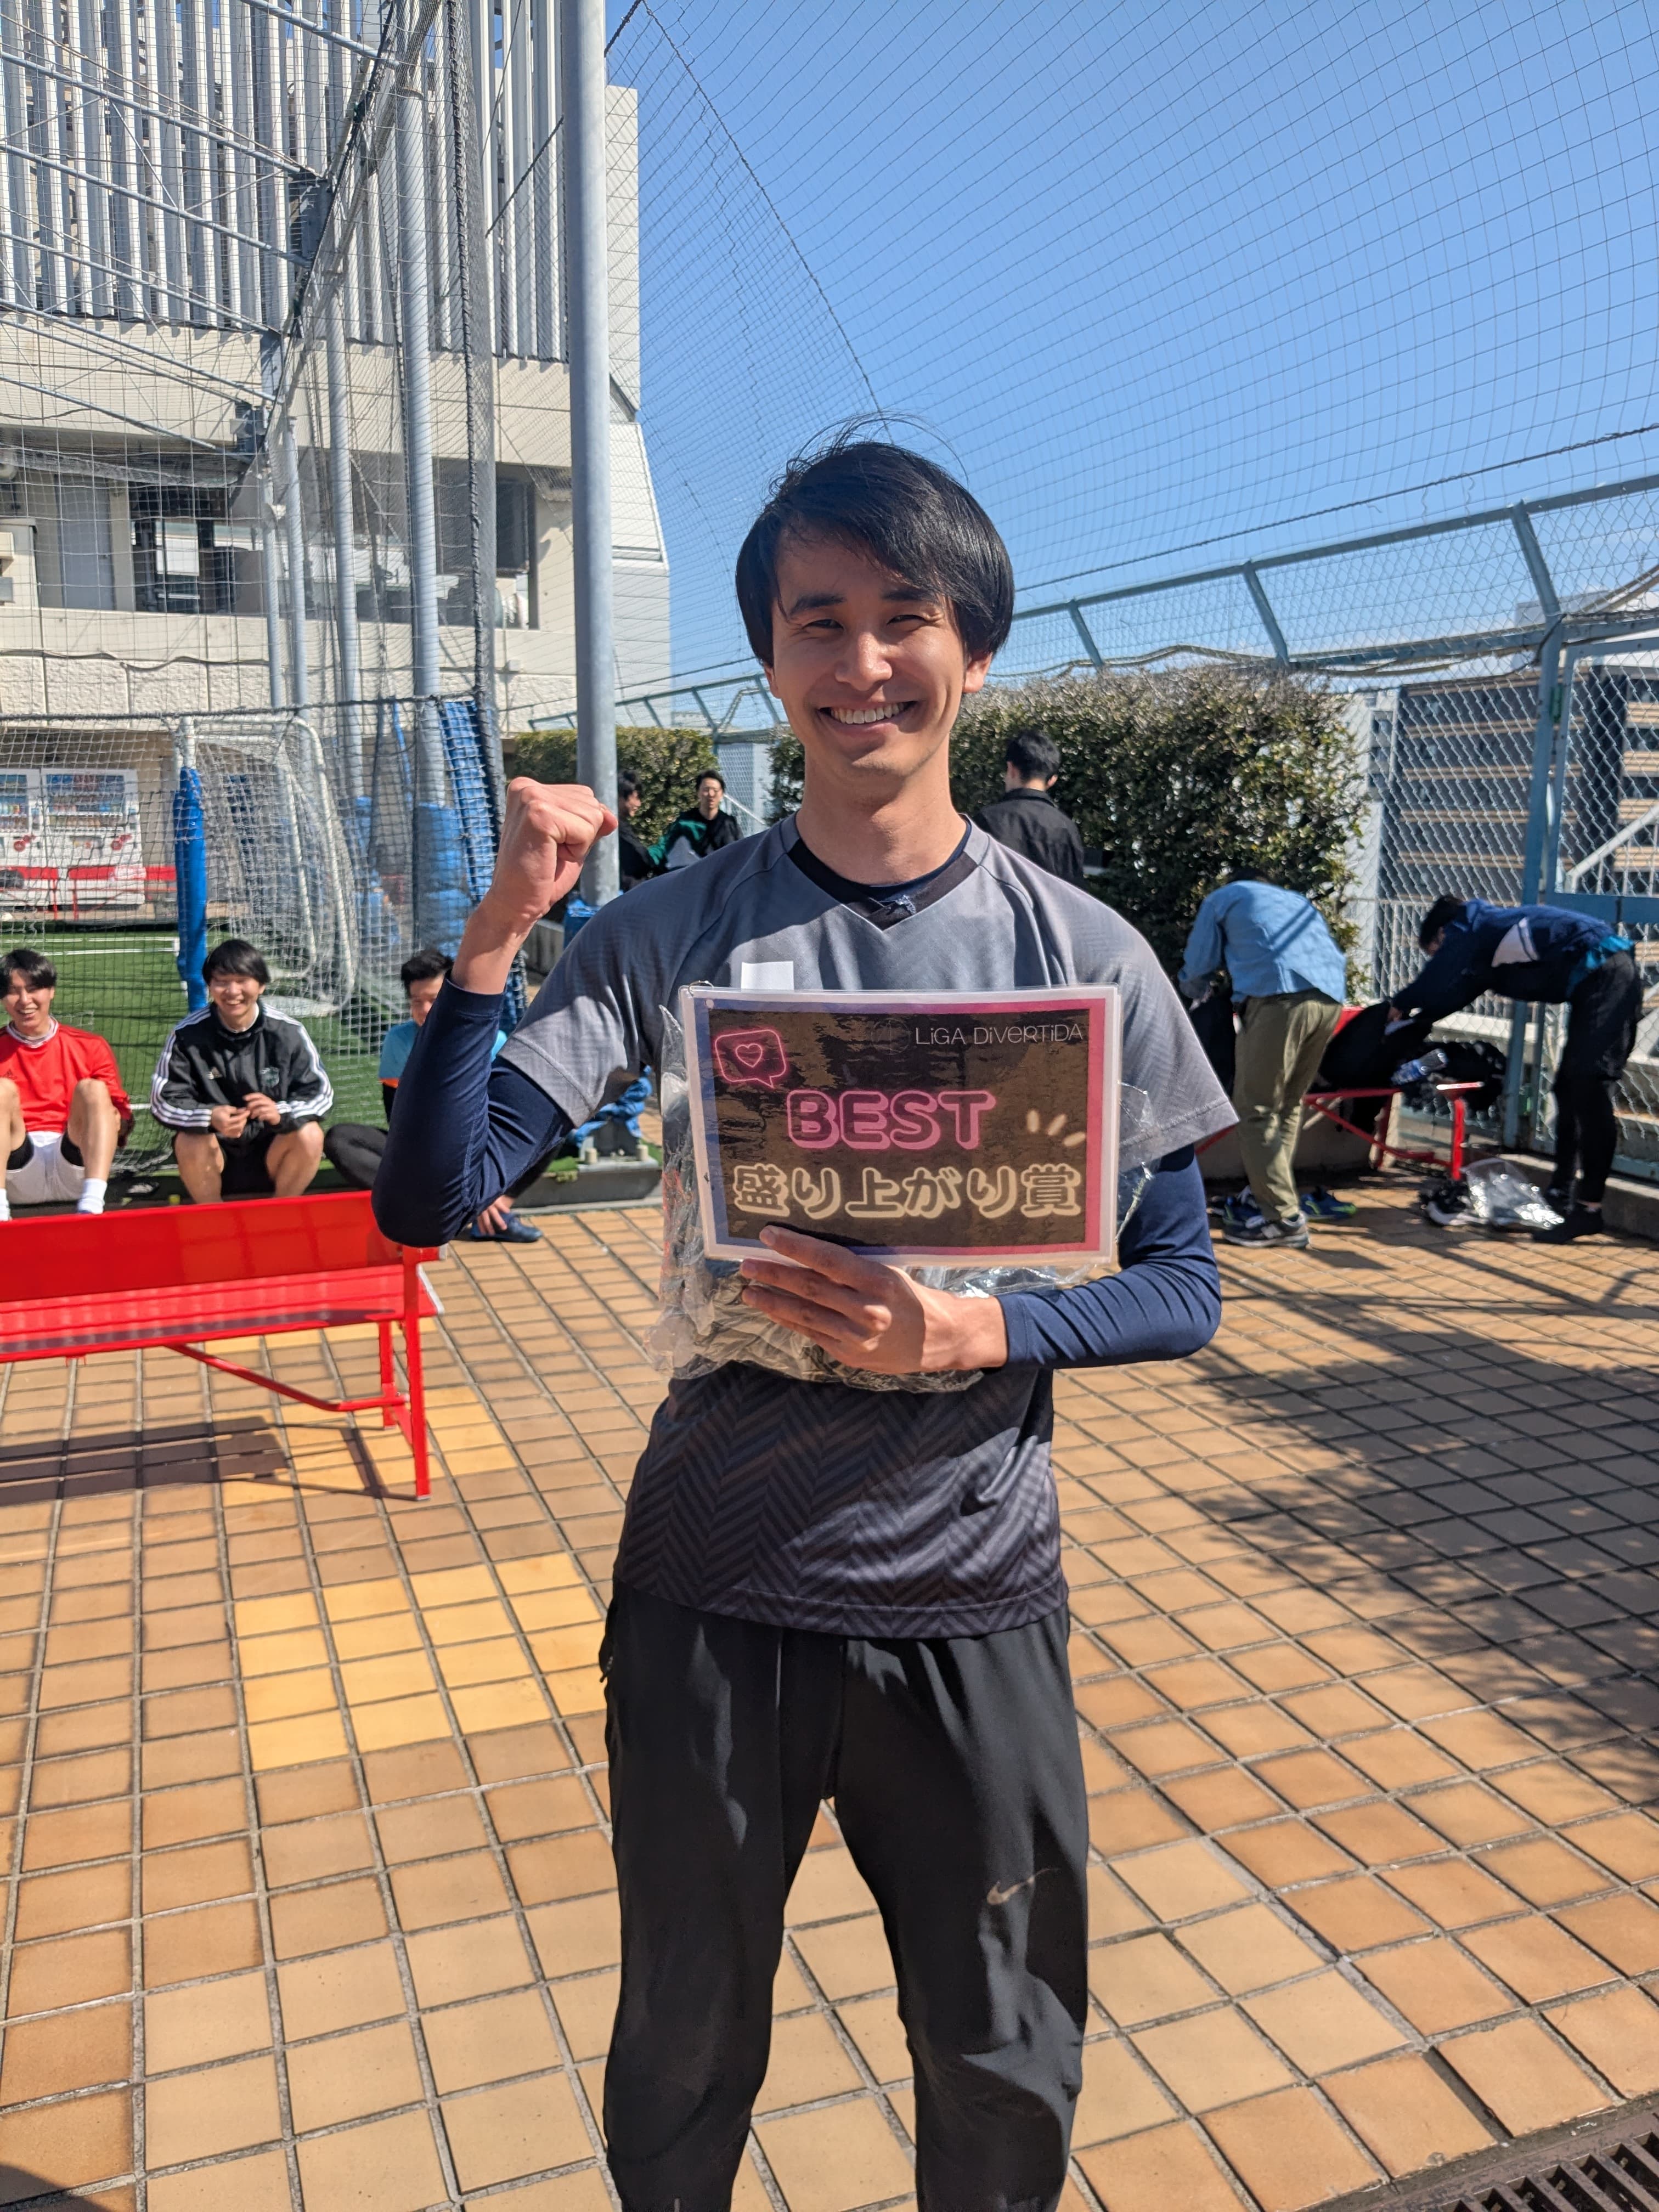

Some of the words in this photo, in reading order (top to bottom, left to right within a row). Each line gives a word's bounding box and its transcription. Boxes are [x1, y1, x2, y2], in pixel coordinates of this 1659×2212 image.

[787, 1090, 996, 1149] BEST
[733, 1163, 1081, 1218] 盛り上がり賞
